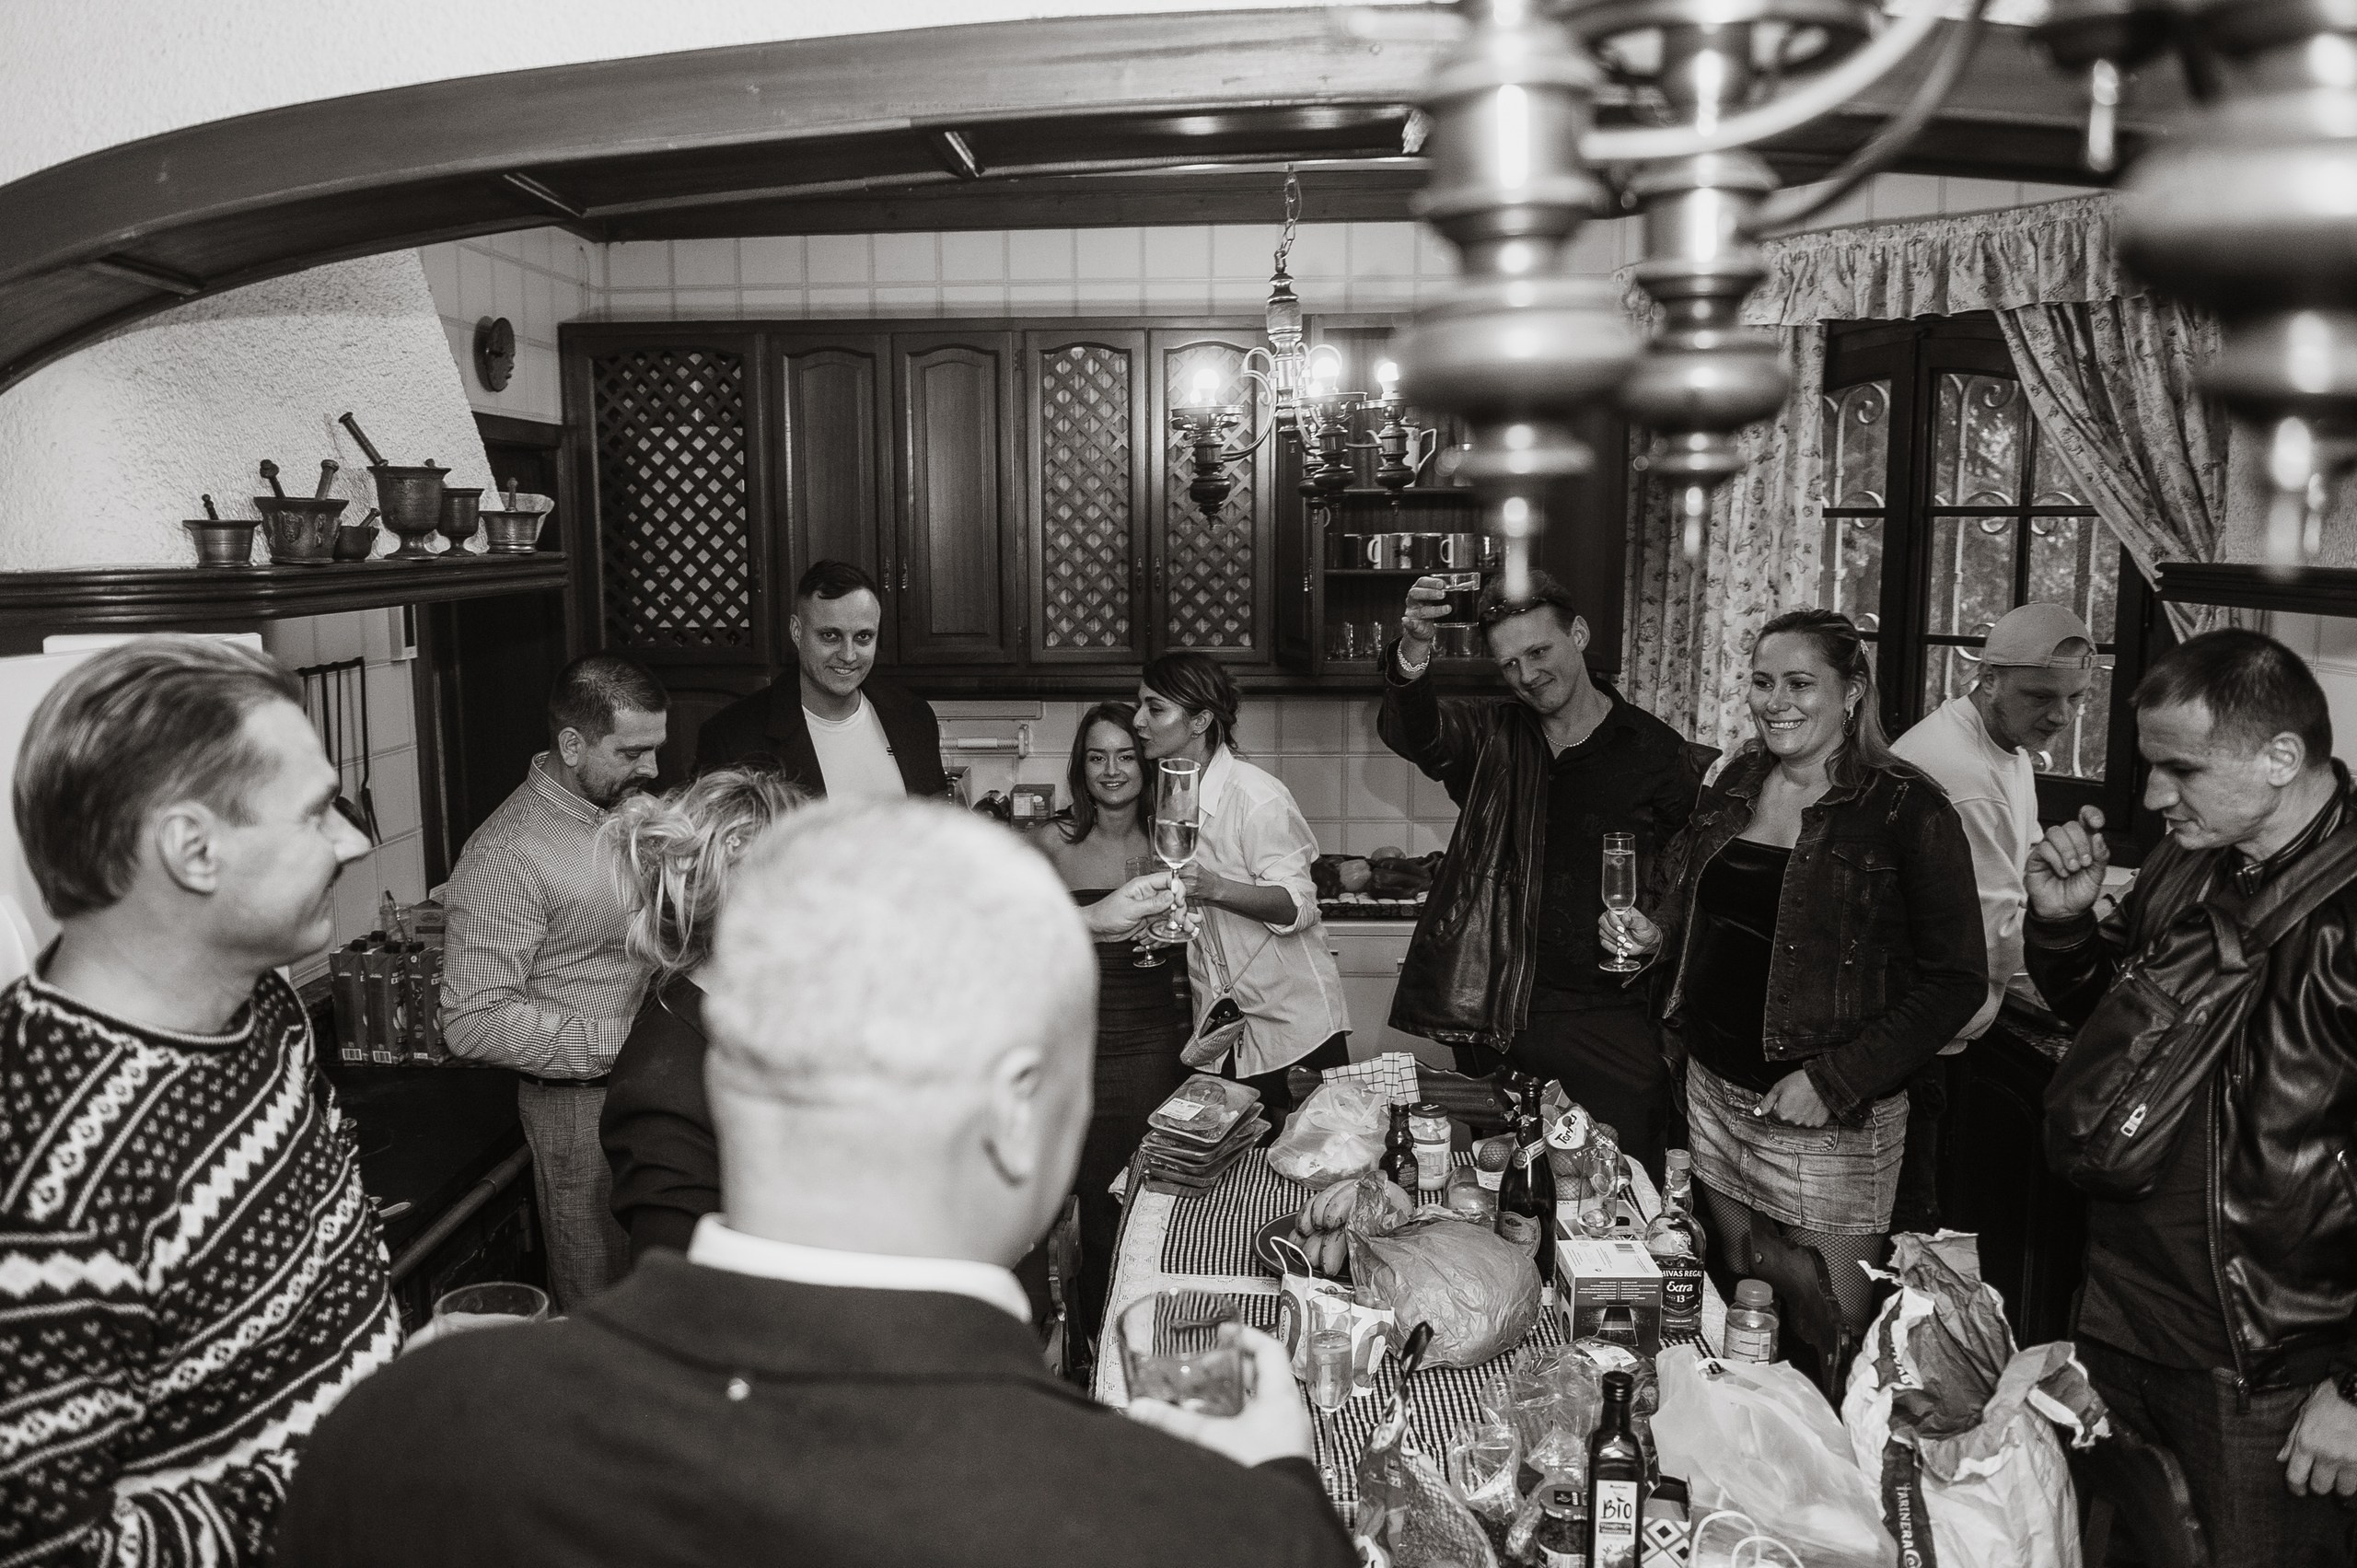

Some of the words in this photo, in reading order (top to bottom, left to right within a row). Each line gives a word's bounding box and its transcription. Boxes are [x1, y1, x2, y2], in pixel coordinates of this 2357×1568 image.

[1554, 1113, 1577, 1144] Torres
[1666, 1281, 1693, 1293] Extra
[1677, 1295, 1686, 1303] 13
